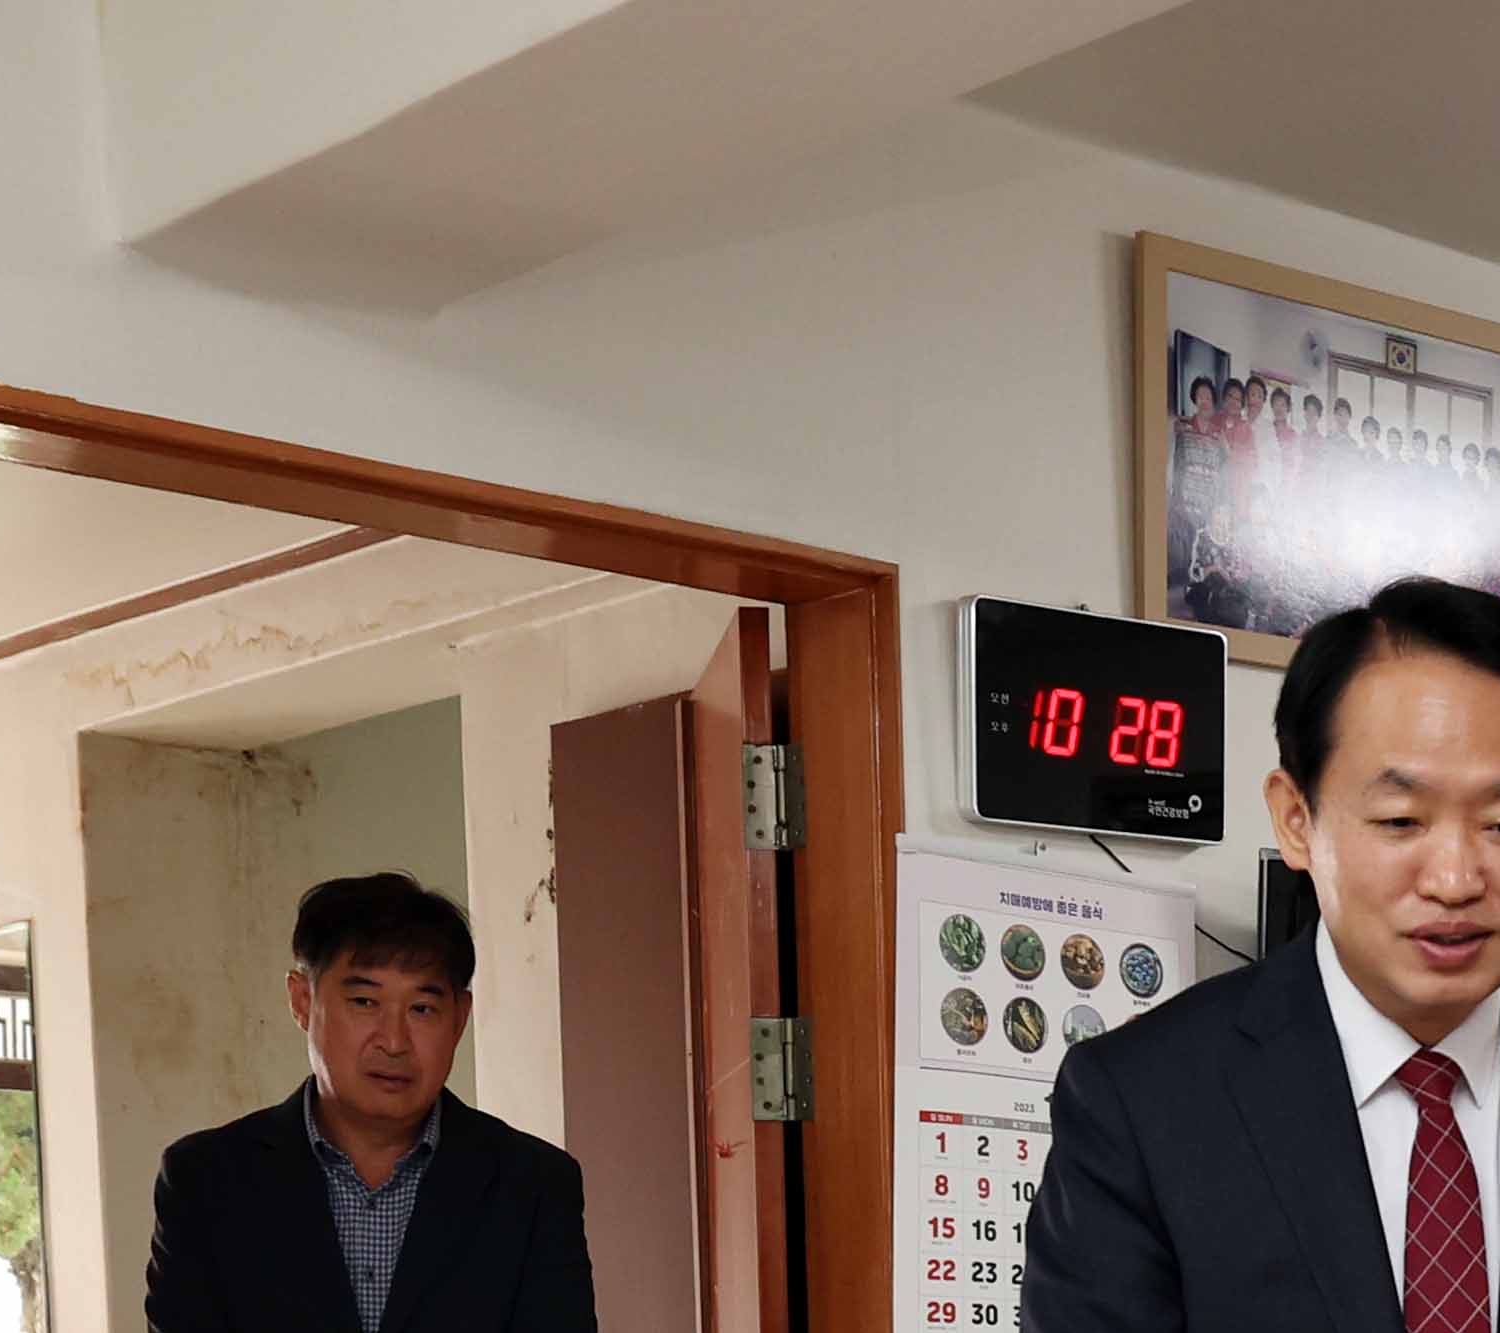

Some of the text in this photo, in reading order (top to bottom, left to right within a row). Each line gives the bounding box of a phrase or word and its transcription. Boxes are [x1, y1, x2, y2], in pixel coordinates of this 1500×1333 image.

[1030, 688, 1183, 768] 10 28
[999, 892, 1054, 914] 치매예방에
[1081, 904, 1103, 921] 음식
[936, 1132, 946, 1153] 1
[977, 1136, 990, 1157] 2
[1016, 1139, 1029, 1161] 3
[934, 1174, 949, 1196] 8
[978, 1177, 990, 1199] 9
[1012, 1180, 1036, 1202] 10
[928, 1216, 956, 1239] 15
[972, 1219, 997, 1242] 16
[1012, 1222, 1023, 1244] 1
[927, 1259, 956, 1281] 22
[971, 1261, 998, 1283] 23
[1012, 1264, 1024, 1285] 2
[927, 1301, 957, 1324] 29
[971, 1303, 998, 1326] 30
